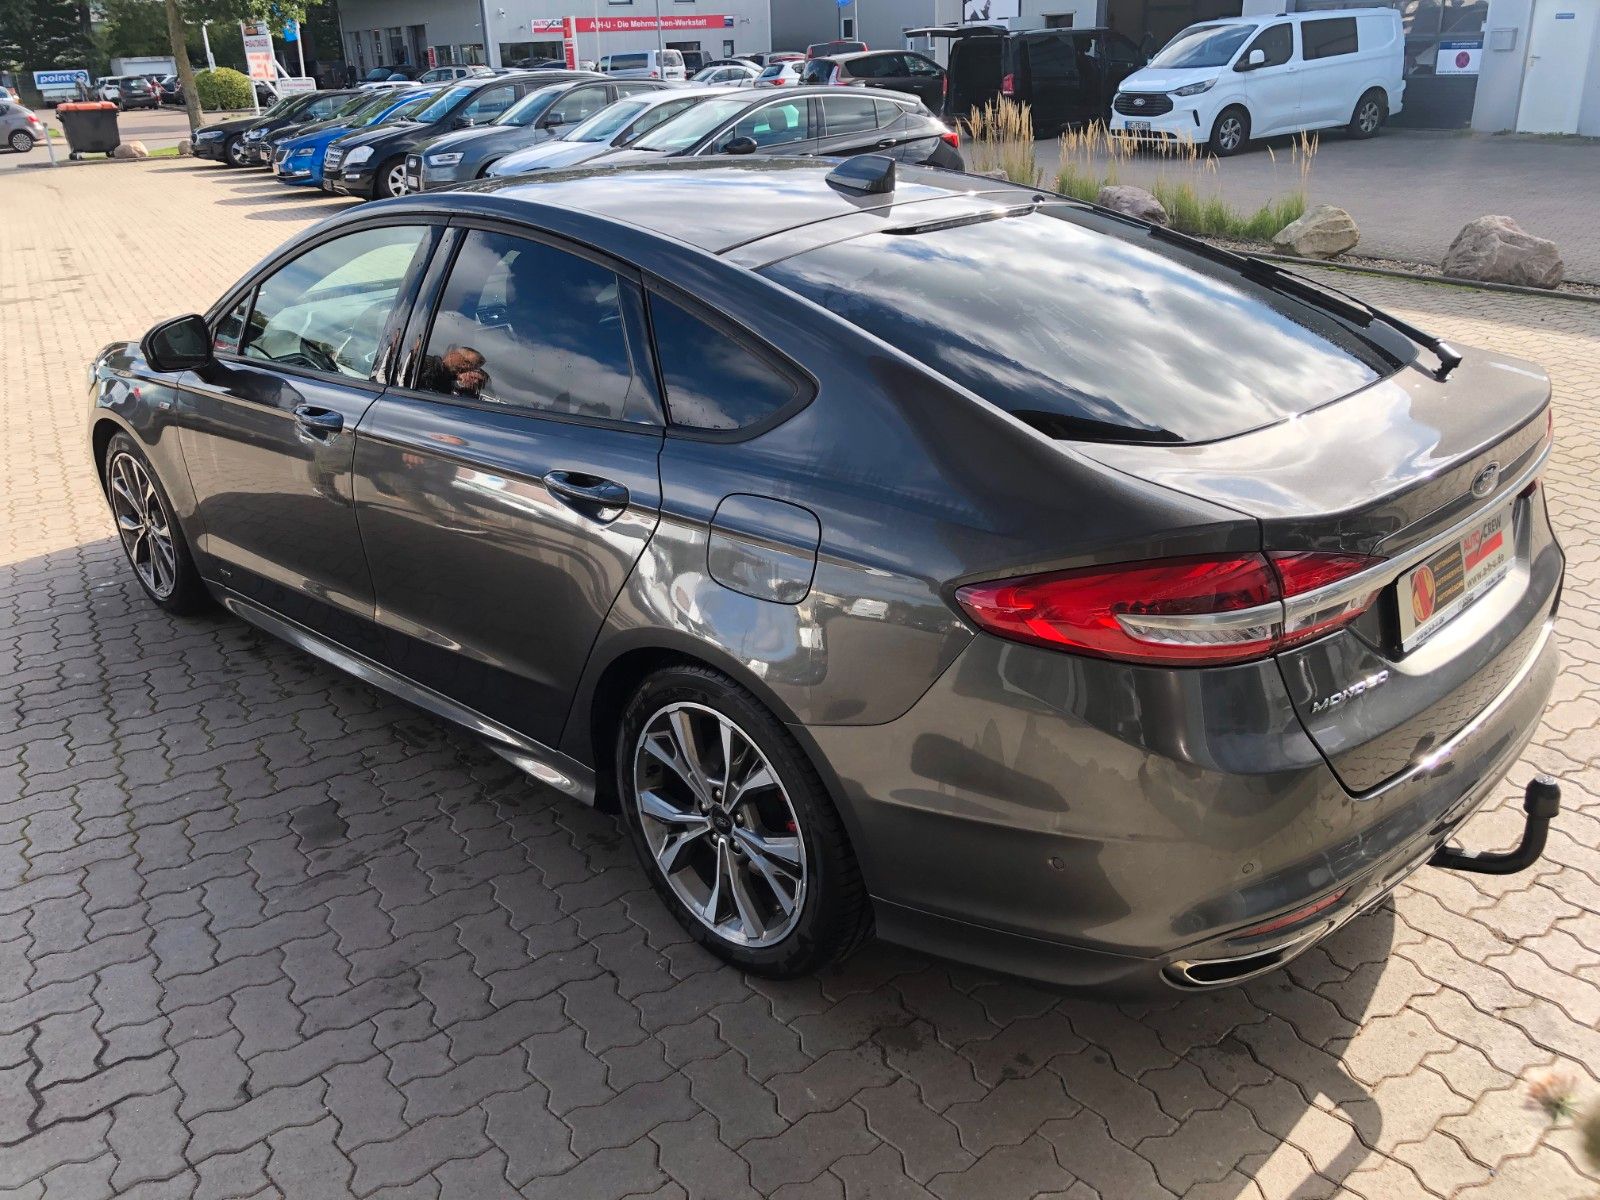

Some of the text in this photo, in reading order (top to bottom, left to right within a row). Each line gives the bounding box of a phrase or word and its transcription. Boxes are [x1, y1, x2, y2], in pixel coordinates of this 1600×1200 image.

[590, 20, 611, 29] AH-U
[617, 20, 630, 28] Die
[630, 18, 707, 28] Mehrmaken-Werkstatt
[40, 73, 71, 84] point
[1463, 512, 1502, 551] AUTO CREW
